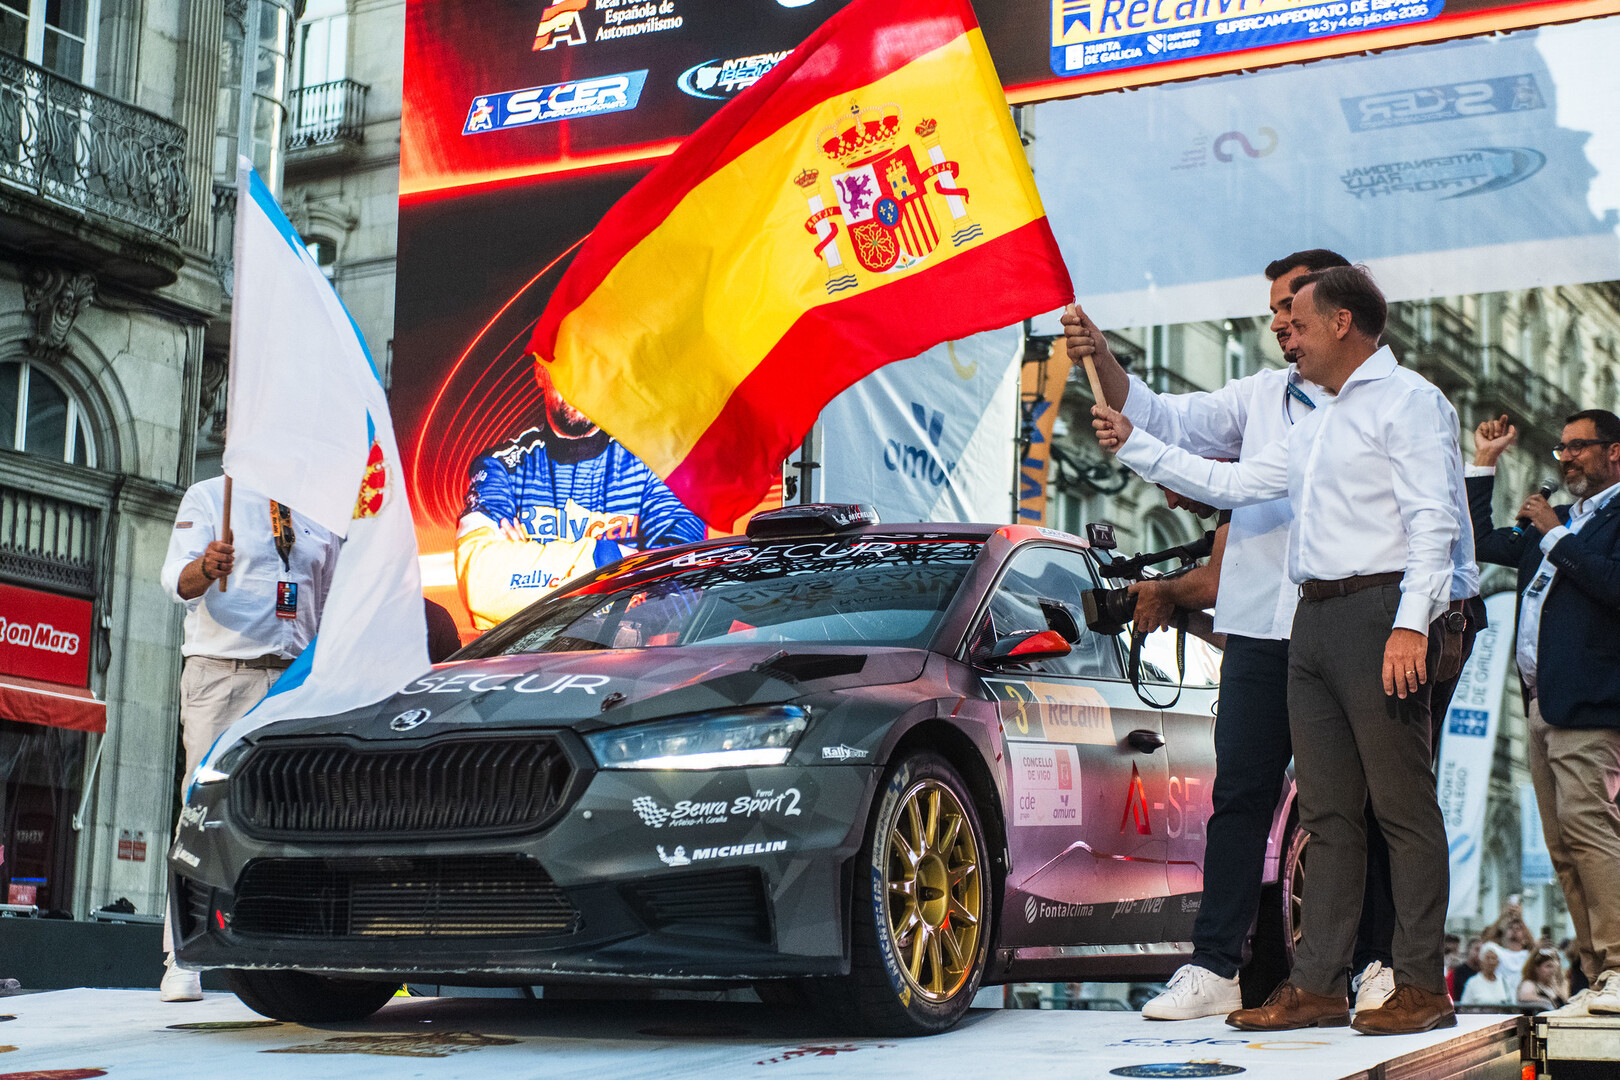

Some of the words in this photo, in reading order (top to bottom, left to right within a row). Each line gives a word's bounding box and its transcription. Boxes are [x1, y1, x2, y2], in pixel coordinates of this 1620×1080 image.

[605, 2, 657, 25] Española
[659, 0, 675, 14] de
[1215, 3, 1348, 35] SUPERCAMPEONATO
[1350, 0, 1369, 14] DE
[1347, 16, 1363, 27] de
[1383, 10, 1398, 21] de
[595, 16, 683, 42] Automovilismo
[1168, 29, 1202, 42] DEPORTE
[1085, 41, 1121, 54] XUNTA
[1168, 38, 1200, 51] GALEGO
[722, 49, 795, 72] INTERNA
[1084, 54, 1099, 66] DE
[1100, 48, 1143, 63] GALICIA
[719, 62, 779, 82] IBERIA
[502, 76, 629, 126] S-CER
[884, 437, 967, 491] amur
[7, 622, 32, 647] on
[32, 623, 80, 655] Mars
[398, 673, 611, 695] SECUR
[1004, 685, 1029, 735] 3
[1045, 694, 1105, 730] Recalvi
[1023, 757, 1053, 767] CONCELLO
[1028, 770, 1036, 780] DE
[1037, 770, 1051, 780] VIGO
[756, 789, 774, 798] Ferrol
[1020, 792, 1036, 810] cde
[1120, 759, 1213, 841] A-SE
[670, 799, 728, 820] Senra
[730, 793, 785, 818] Sport
[784, 788, 802, 817] 2
[1053, 808, 1076, 819] amura
[692, 840, 787, 860] MICHELIN
[1040, 902, 1094, 919] Fontalclima
[873, 876, 899, 977] MICHELIN
